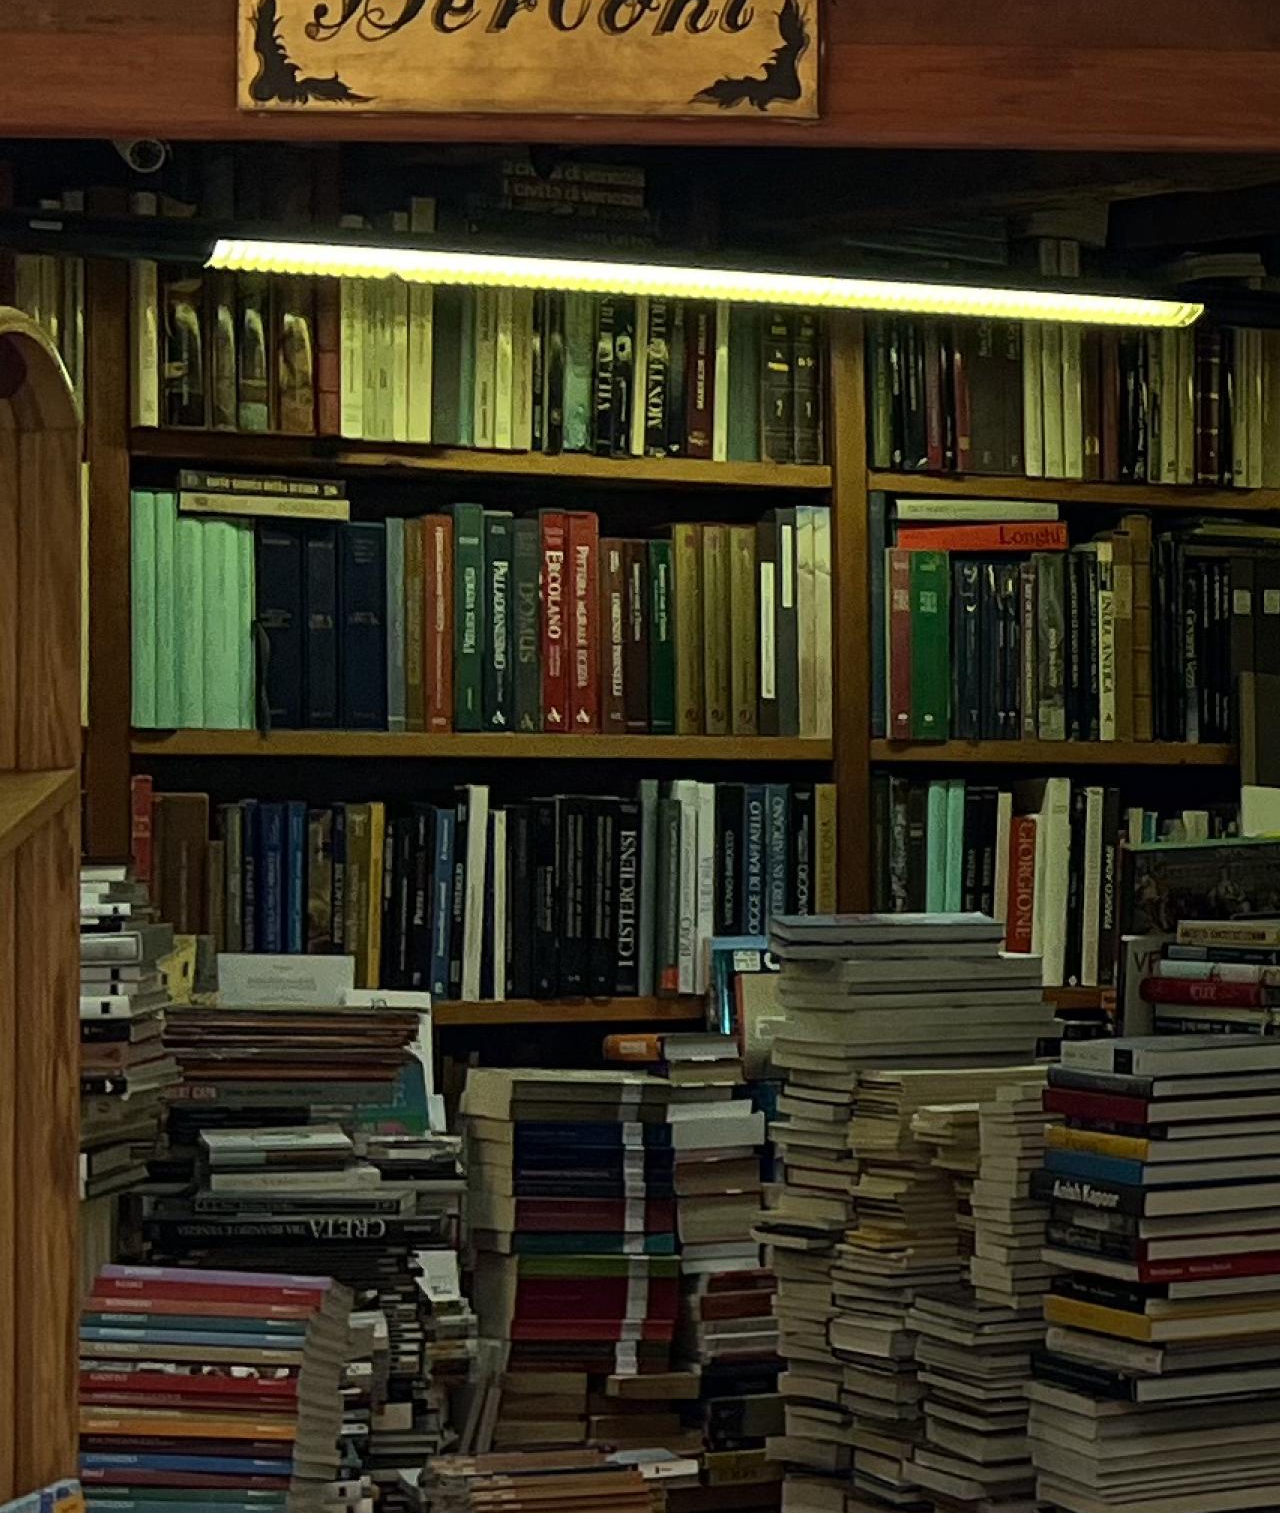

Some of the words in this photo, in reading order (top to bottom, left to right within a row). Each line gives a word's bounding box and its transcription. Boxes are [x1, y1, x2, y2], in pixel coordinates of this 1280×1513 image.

[998, 525, 1063, 547] Longhi
[543, 550, 563, 639] ERCOLANO
[618, 828, 638, 956] CISTERCIENSI
[1014, 821, 1033, 939] GIORGIONE
[308, 1217, 386, 1238] CRETA
